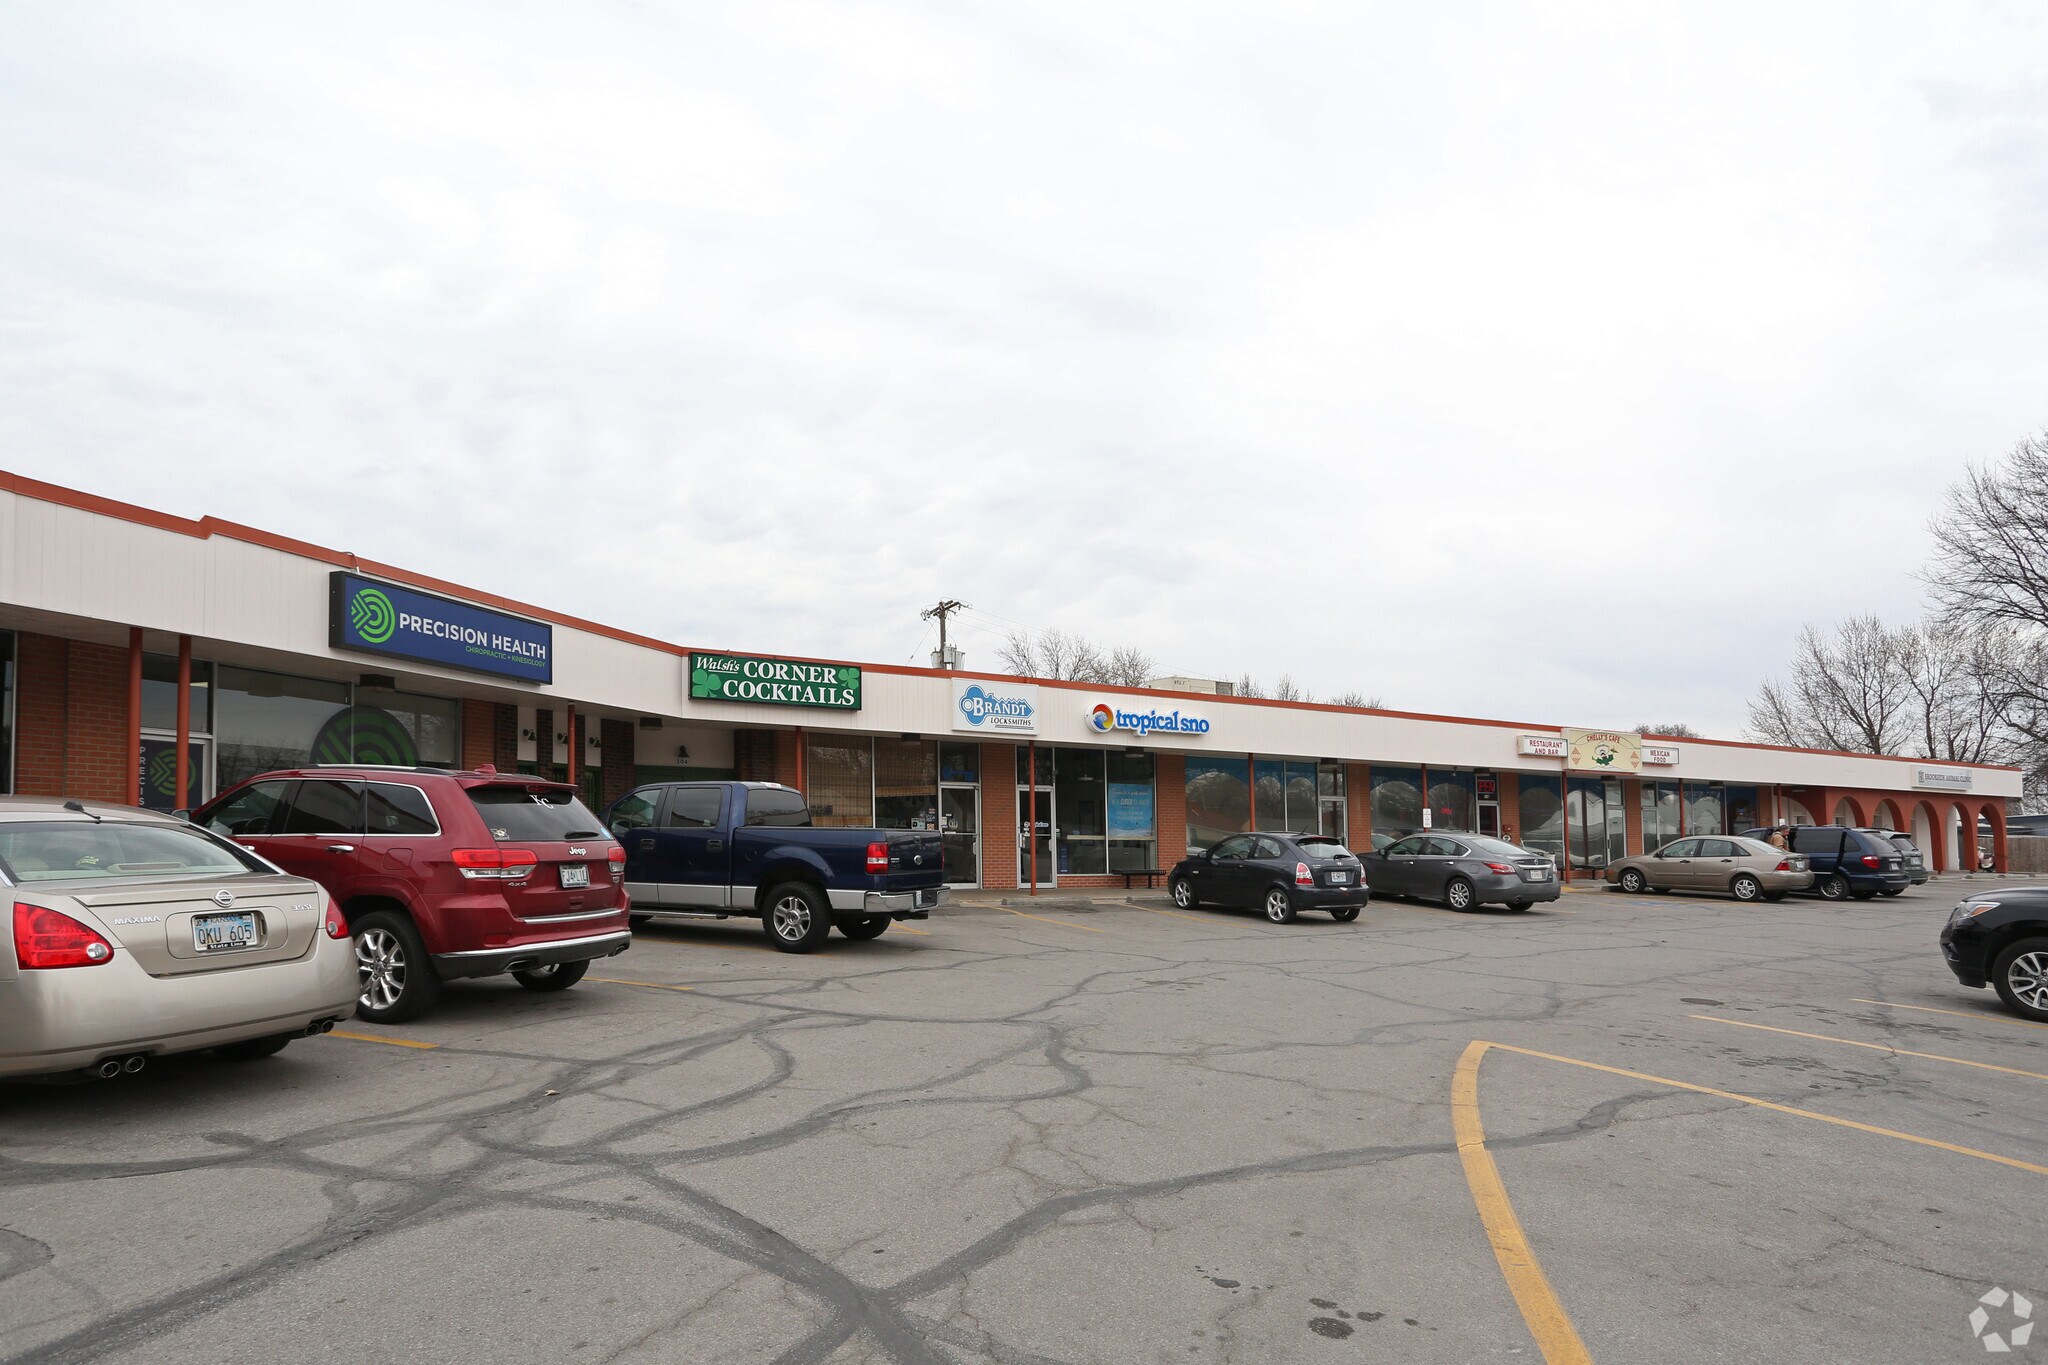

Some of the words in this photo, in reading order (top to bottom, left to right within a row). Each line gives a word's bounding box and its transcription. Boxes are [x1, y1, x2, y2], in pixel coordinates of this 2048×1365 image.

[400, 613, 488, 647] PRECISION
[492, 634, 546, 660] HEALTH
[465, 645, 507, 660] CHIROPRACTIC
[511, 656, 546, 668] KINESIOLOGY
[696, 657, 740, 673] Walsh's
[743, 661, 838, 684] CORNER
[723, 680, 855, 705] COCKTAILS
[972, 698, 1028, 717] BRANDT
[990, 717, 1032, 727] LOCKSMITHS
[1116, 709, 1180, 735] tropical
[1180, 717, 1210, 734] sno
[1529, 739, 1563, 749] RESTAURANT
[1609, 734, 1621, 744] CAFE
[1649, 749, 1671, 758] MEXICAN
[1924, 773, 1945, 781] BROOKSIDE
[568, 846, 587, 856] Jeep
[114, 915, 161, 926] MAXIMA
[198, 927, 222, 945] QKU
[229, 924, 252, 942] 605
